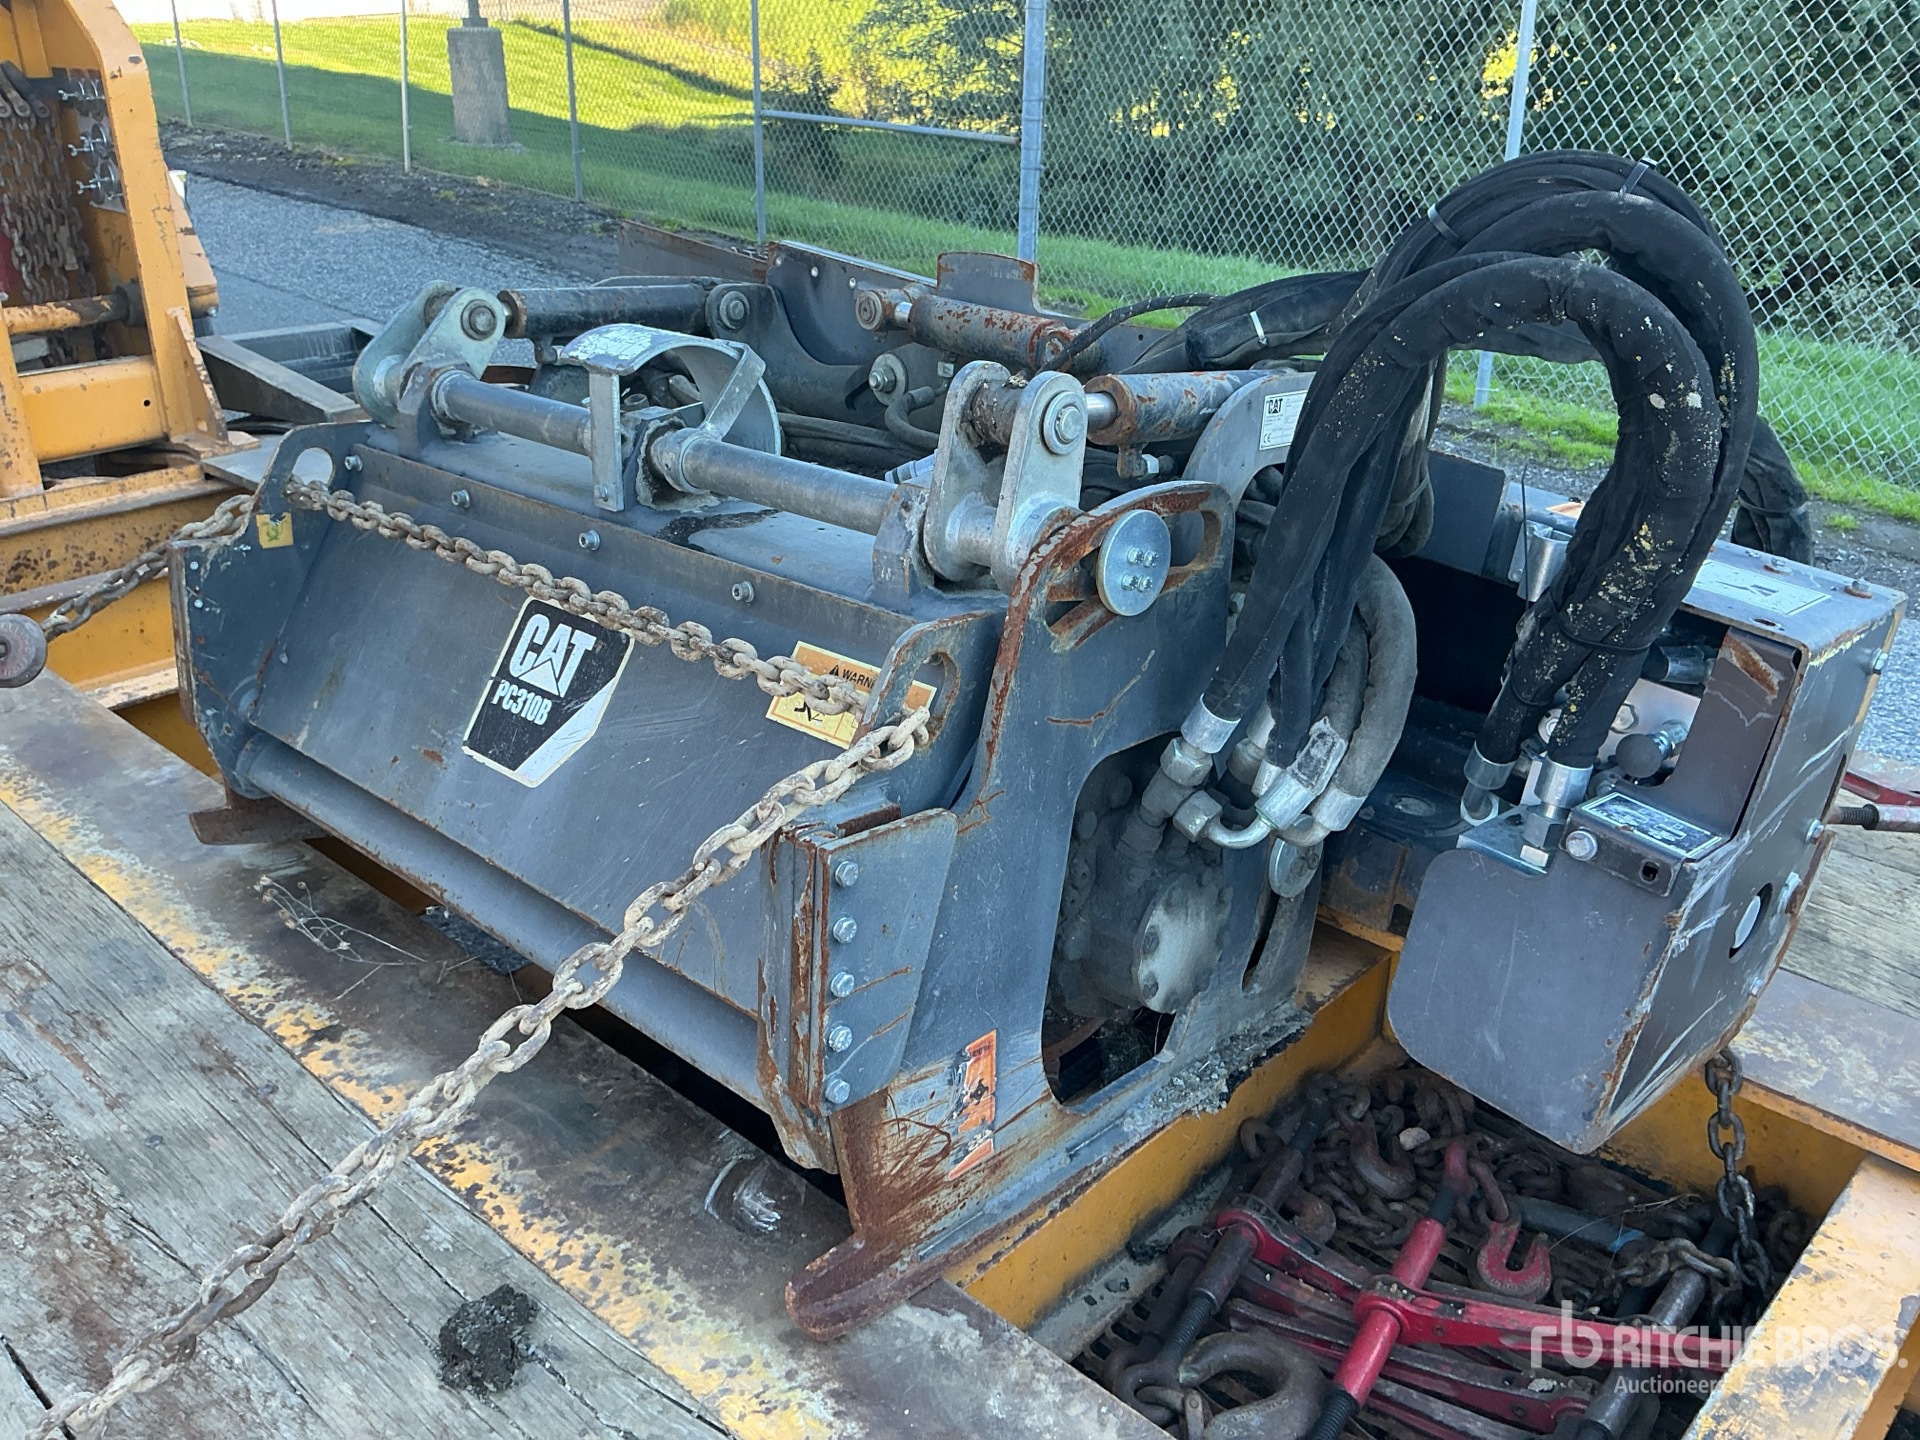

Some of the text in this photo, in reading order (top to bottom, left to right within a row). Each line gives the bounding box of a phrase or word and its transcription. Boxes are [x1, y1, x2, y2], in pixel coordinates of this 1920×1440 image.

[1268, 398, 1284, 414] CAT
[509, 613, 597, 698] CAT
[842, 668, 876, 689] WARN
[491, 679, 553, 726] PC310B
